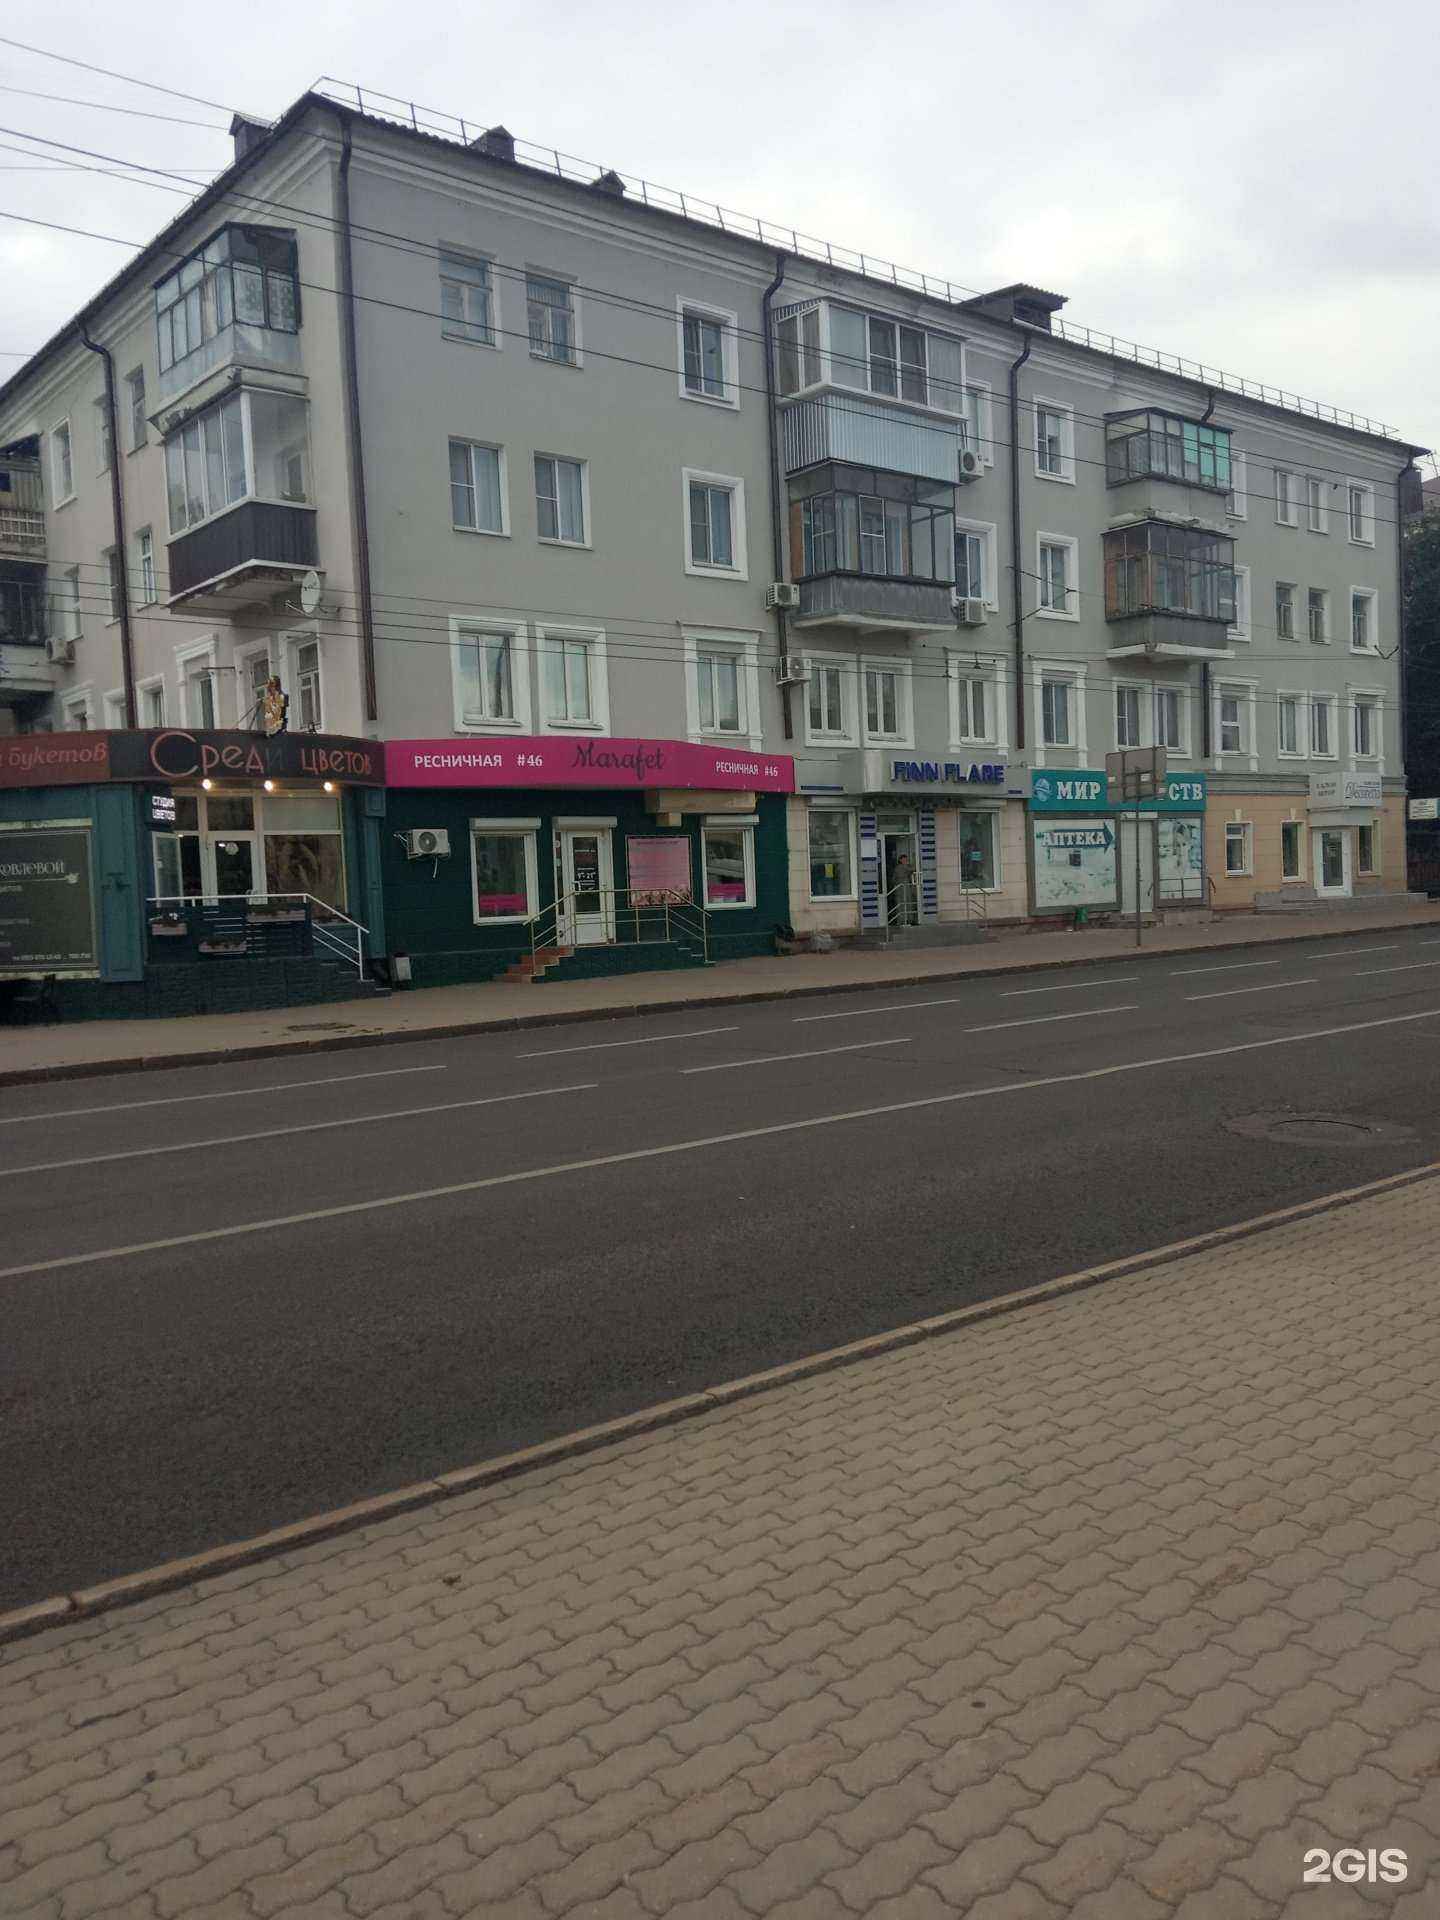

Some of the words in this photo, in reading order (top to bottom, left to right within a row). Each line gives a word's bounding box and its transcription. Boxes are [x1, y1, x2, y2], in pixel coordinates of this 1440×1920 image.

[413, 754, 502, 768] РЕСНИЧНАЯ
[517, 754, 543, 767] #46
[571, 741, 665, 781] Marafet
[715, 761, 759, 775] РЕСНИЧНАЯ
[891, 761, 939, 781] FINN
[943, 763, 1005, 783] FLARE
[1056, 781, 1101, 800] МИР
[1040, 832, 1105, 848] АПТЕКА
